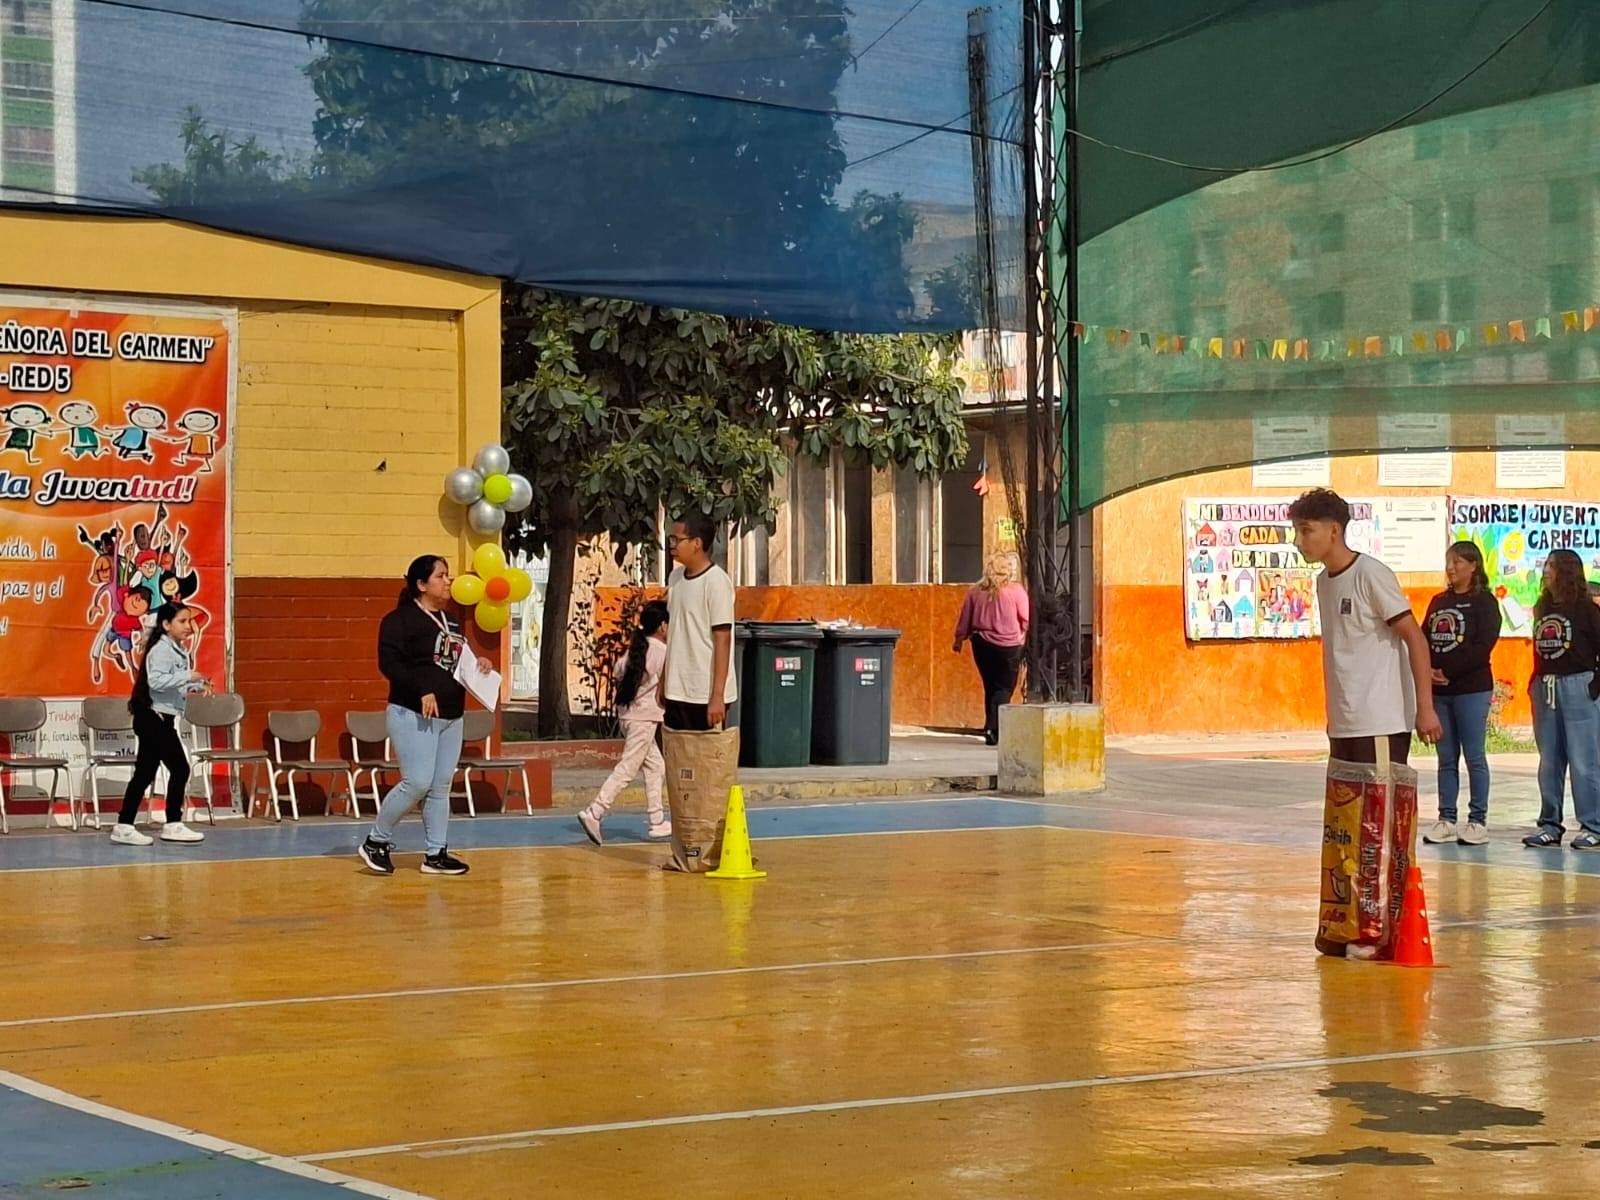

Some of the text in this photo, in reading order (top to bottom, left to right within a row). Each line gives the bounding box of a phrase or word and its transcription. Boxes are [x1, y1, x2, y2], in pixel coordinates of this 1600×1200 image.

[0, 321, 66, 353] ÑORA
[73, 330, 111, 356] DEL
[37, 471, 195, 502] Juventud!
[1200, 504, 1218, 520] MI
[1240, 526, 1280, 545] CADA
[42, 538, 56, 558] la
[1232, 550, 1252, 568] DE
[1255, 551, 1271, 568] MI
[1, 576, 64, 602] paz y el
